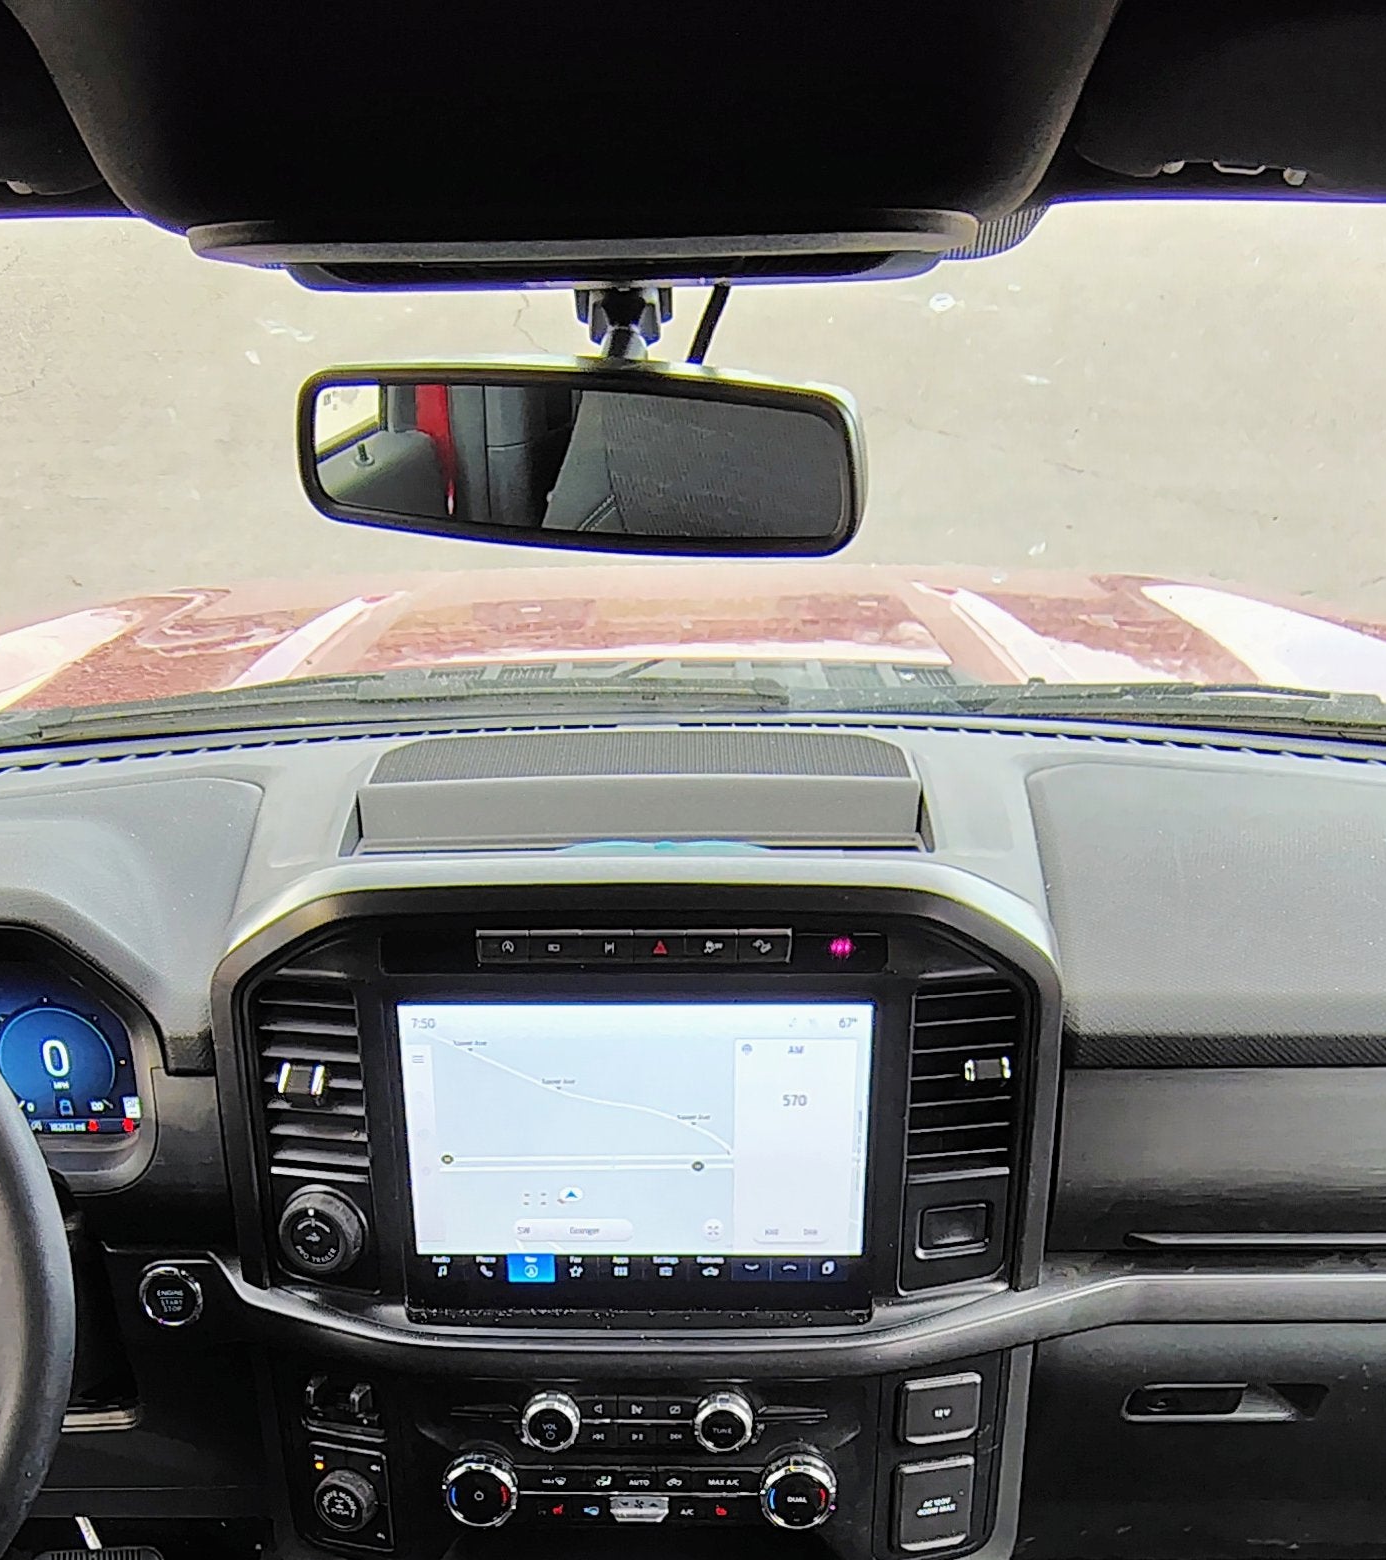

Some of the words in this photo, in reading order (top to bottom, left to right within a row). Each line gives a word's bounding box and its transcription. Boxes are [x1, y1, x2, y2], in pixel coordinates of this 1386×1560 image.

[411, 1018, 436, 1029] 7:50
[42, 1039, 70, 1077] 0
[782, 1094, 808, 1107] 570
[542, 1423, 558, 1431] VOL
[713, 1427, 733, 1435] TUNE
[628, 1479, 650, 1487] AUTO
[726, 1479, 740, 1487] A/C
[786, 1495, 808, 1504] DUAL
[680, 1508, 695, 1516] A/C
